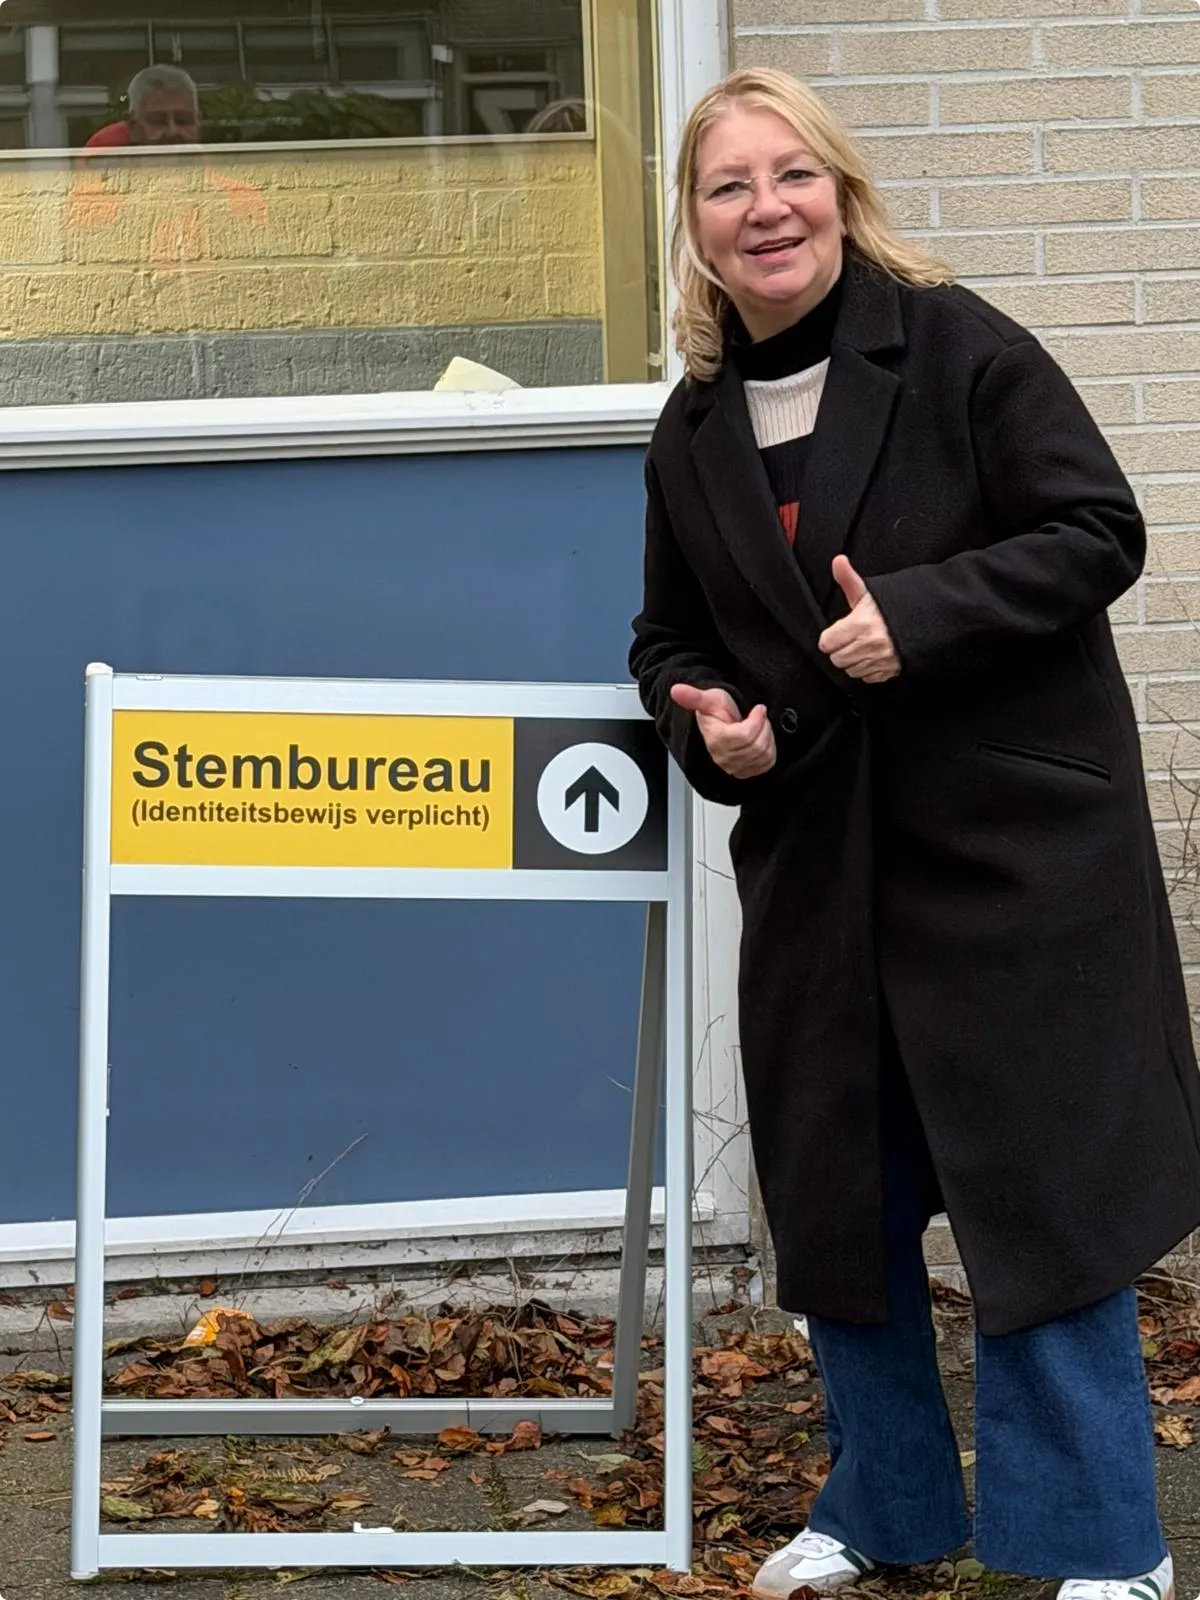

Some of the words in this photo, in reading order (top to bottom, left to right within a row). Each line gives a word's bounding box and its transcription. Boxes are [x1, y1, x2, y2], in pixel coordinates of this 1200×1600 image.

[132, 741, 492, 792] Stembureau
[132, 799, 357, 830] (Identiteitsbewijs
[366, 805, 490, 832] verplicht)
